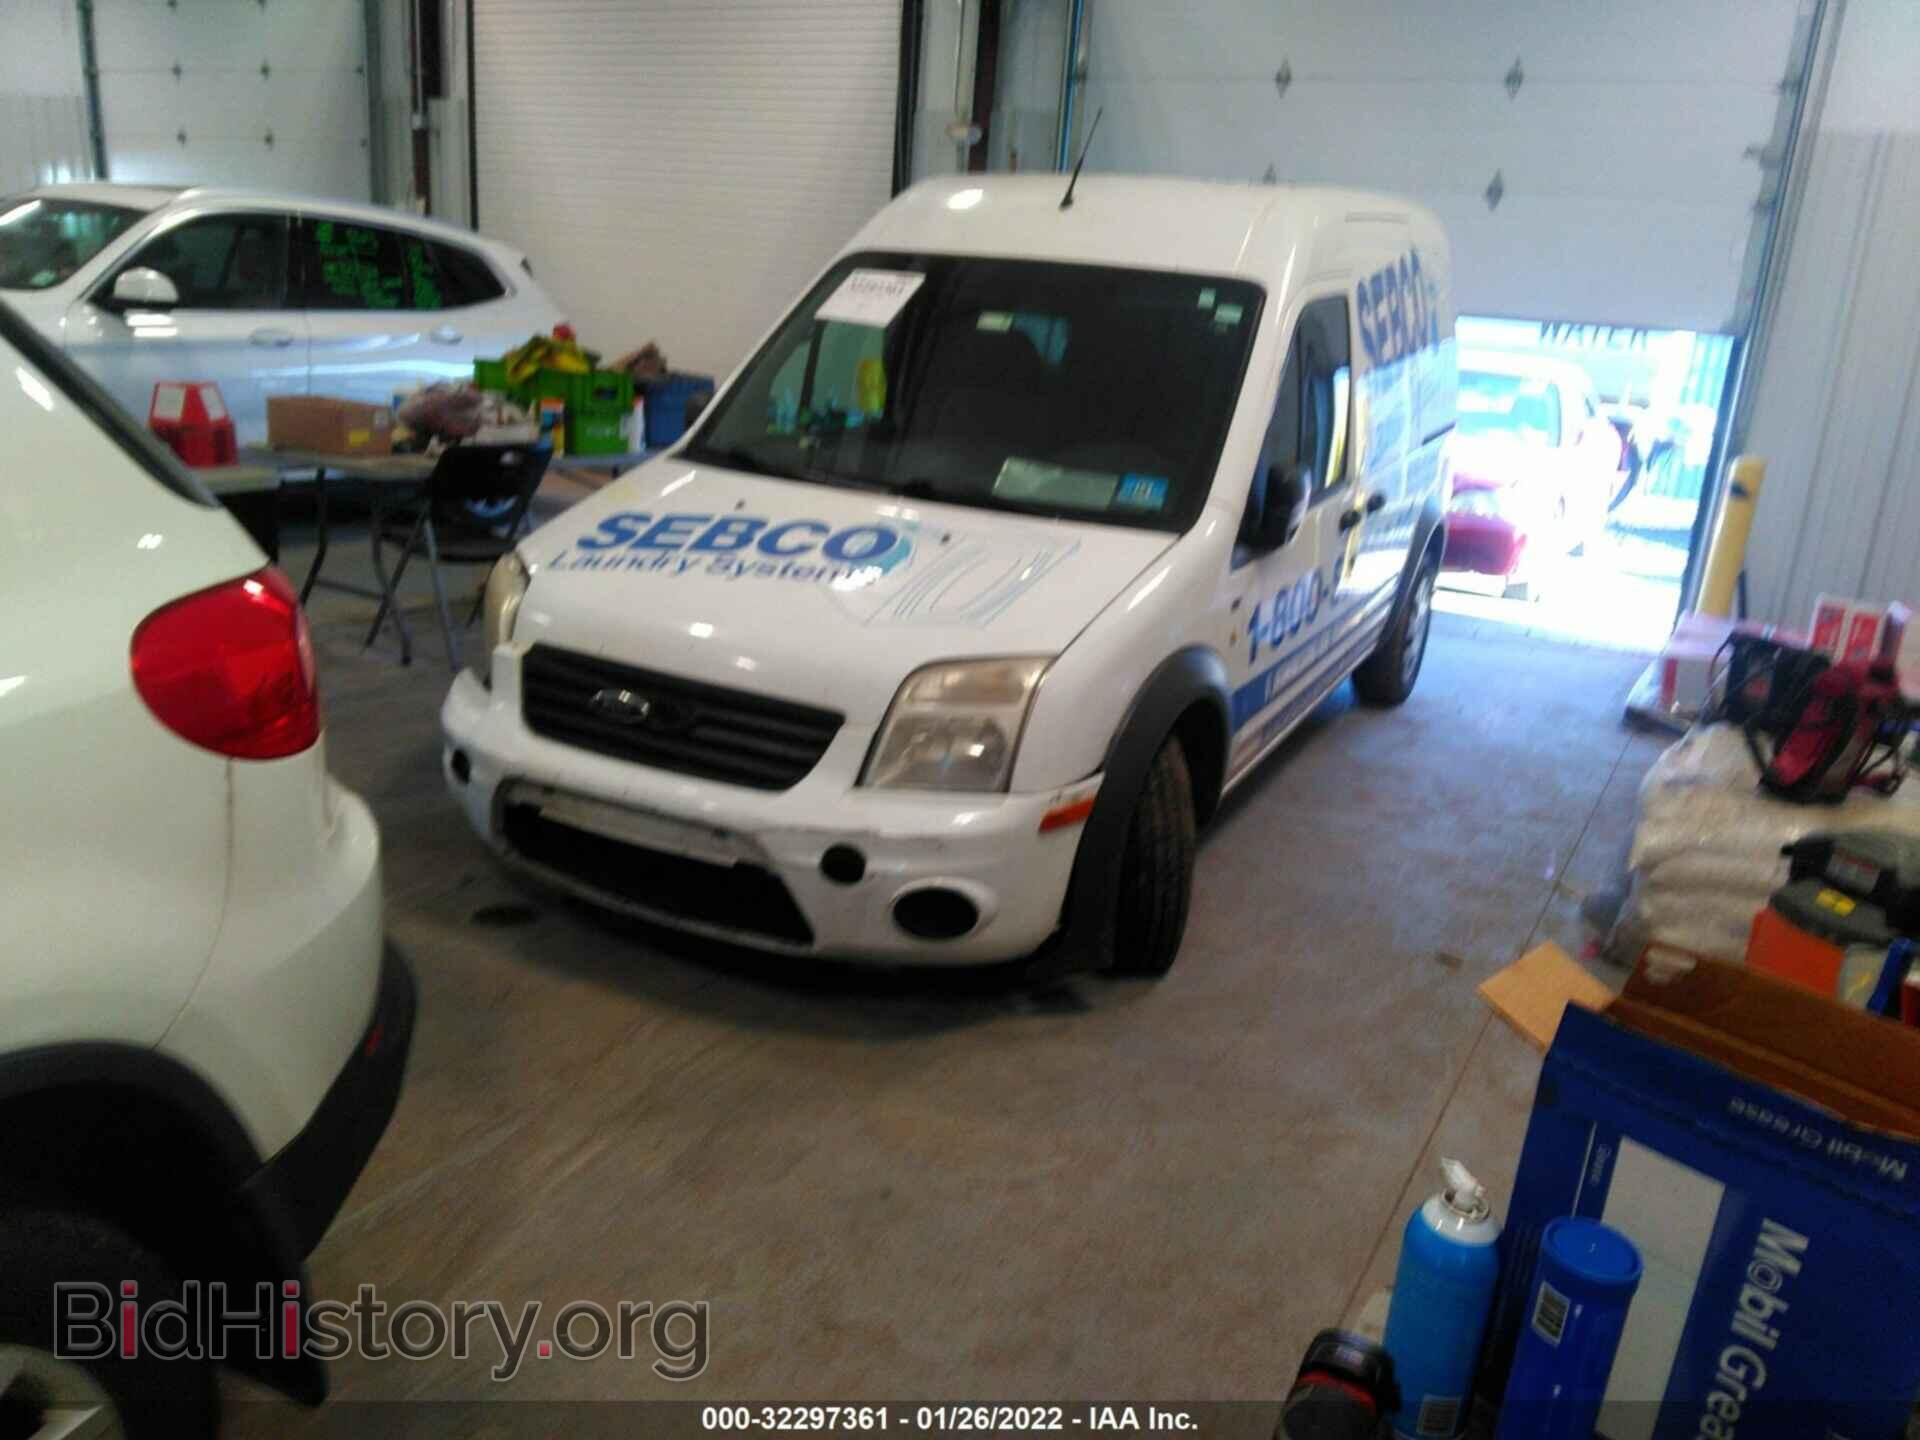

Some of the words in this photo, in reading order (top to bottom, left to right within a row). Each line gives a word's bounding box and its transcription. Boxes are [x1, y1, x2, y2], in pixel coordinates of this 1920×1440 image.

[576, 512, 898, 562] SEBCO
[549, 549, 691, 576] Laundry
[1730, 1216, 1809, 1351] Mobil
